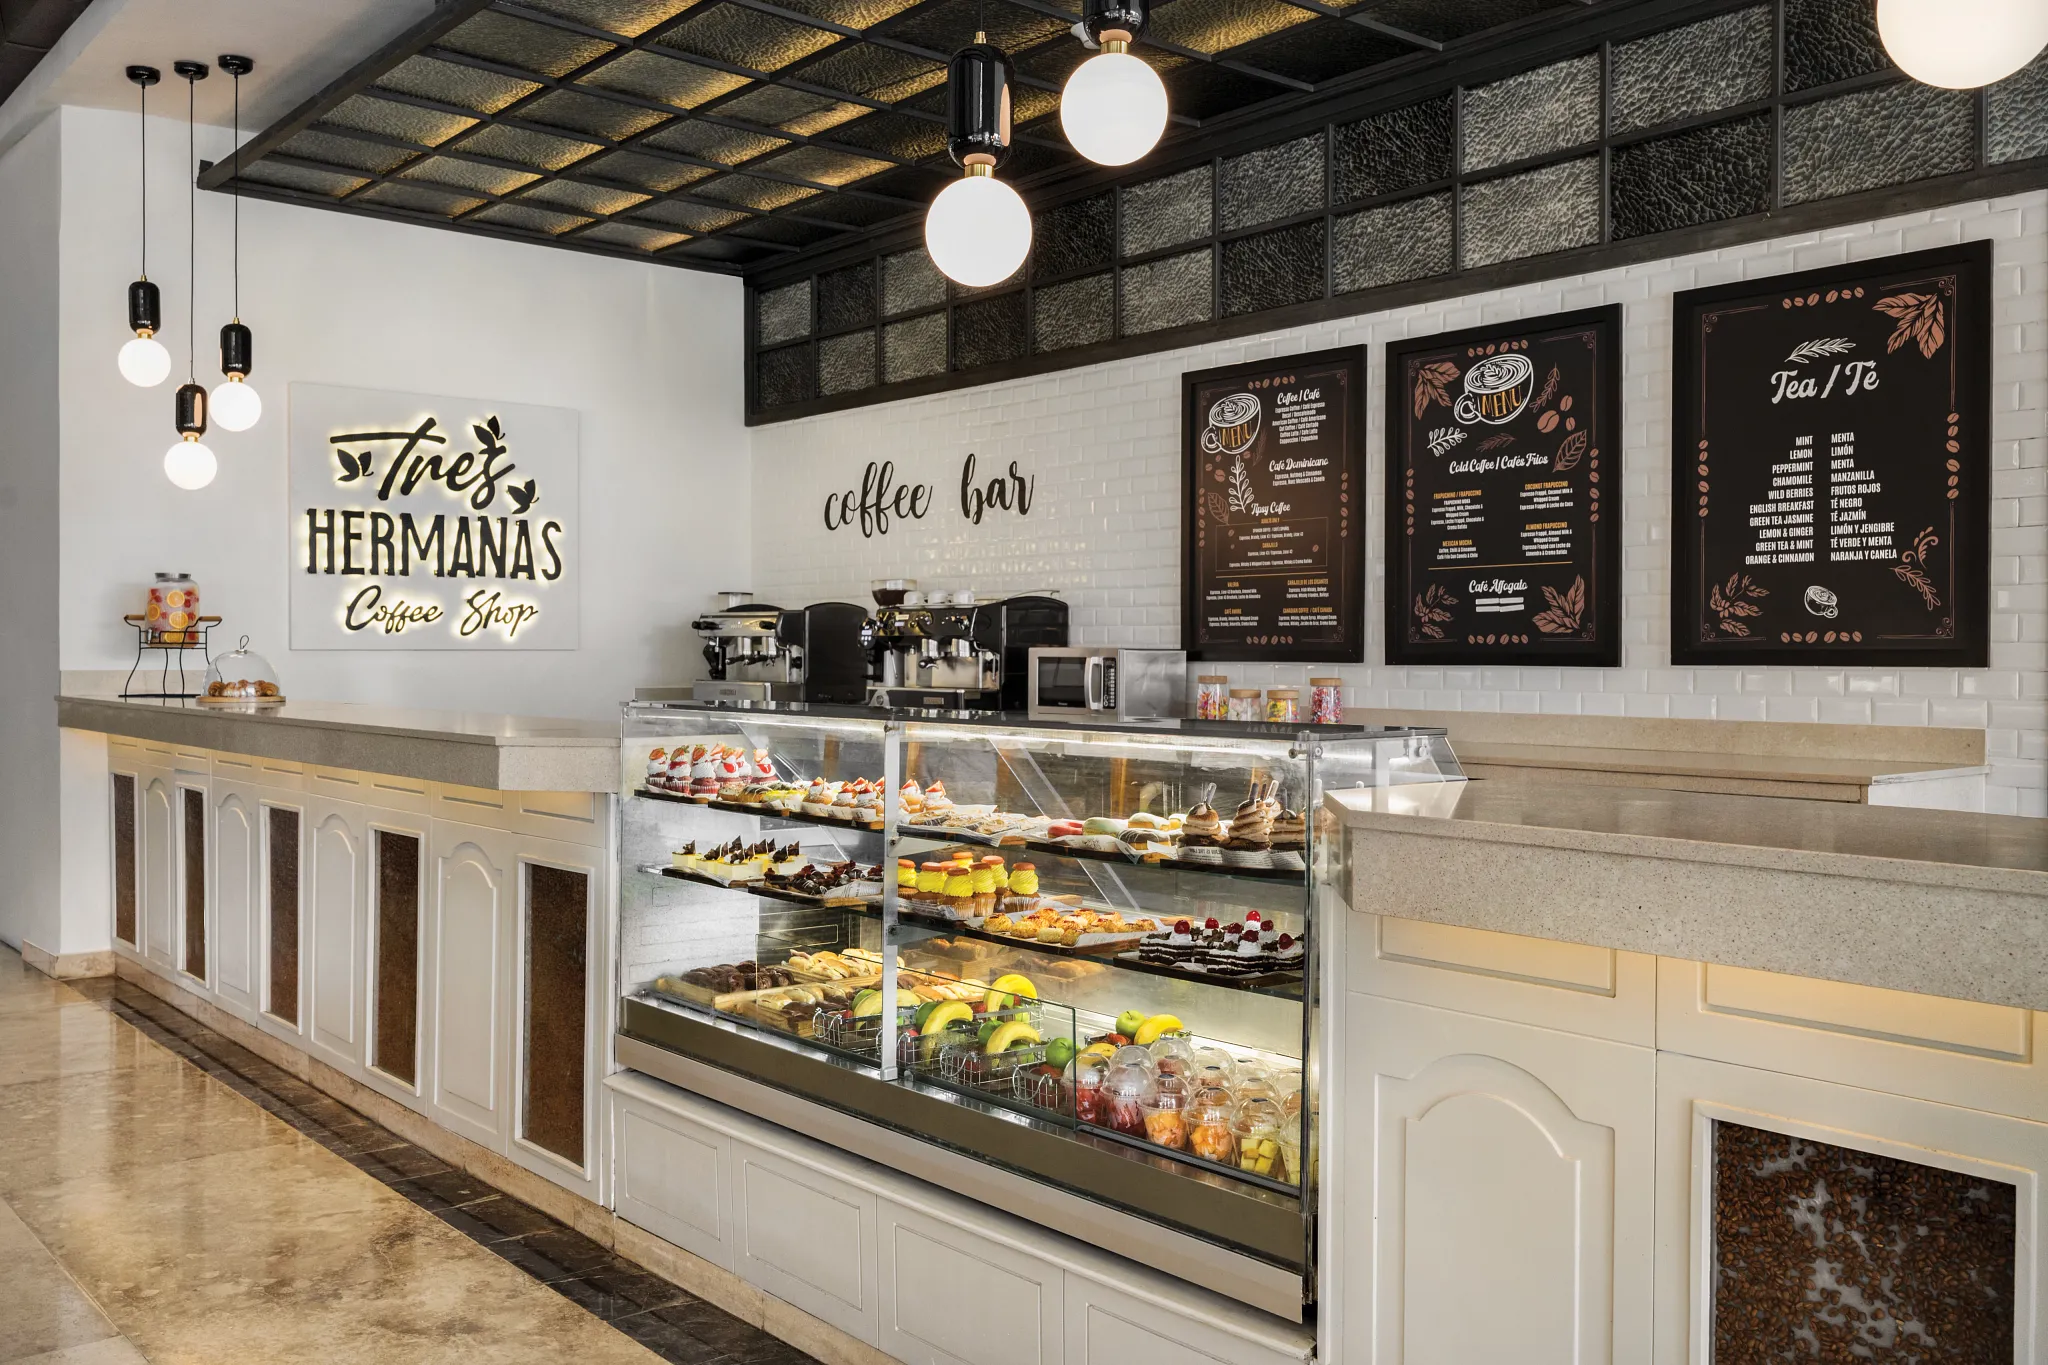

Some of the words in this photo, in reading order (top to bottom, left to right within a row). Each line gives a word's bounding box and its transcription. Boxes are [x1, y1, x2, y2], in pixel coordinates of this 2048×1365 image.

[1770, 370, 1818, 404] Tea
[1820, 364, 1841, 398] /
[1845, 360, 1879, 396] Té
[1277, 392, 1298, 406] Coffee
[1304, 388, 1320, 401] Café
[1482, 386, 1521, 417] MENU
[1796, 435, 1813, 446] MINT
[1831, 432, 1854, 443] MENTA
[1790, 448, 1812, 460] LEMON
[1831, 443, 1853, 456] LIMÓN
[330, 417, 515, 510] Tres
[1269, 460, 1285, 472] Café
[1286, 458, 1328, 470] Dominicano
[1449, 460, 1469, 474] Cold
[1469, 459, 1494, 474] Coffee
[1495, 457, 1500, 470] /
[1501, 456, 1524, 469] Cafés
[1772, 461, 1813, 474] PEPPERMINT
[1831, 458, 1854, 470] MENTA
[1773, 474, 1812, 487] CHAMOMILE
[1831, 470, 1875, 483] MANZANILLA
[824, 461, 933, 538] coffee
[961, 453, 1034, 525] bar
[1768, 490, 1784, 500] WILD
[1786, 488, 1813, 498] BERRIES
[1831, 484, 1856, 496] FRUTOS
[1858, 482, 1881, 494] ROJOS
[1251, 503, 1269, 516] Tipsy
[1270, 502, 1291, 515] Coffee
[1750, 503, 1776, 514] ENGLISH
[1778, 500, 1814, 512] BREAKFAST
[1831, 498, 1838, 509] TÉ
[1840, 498, 1862, 508] NEGRO
[1750, 516, 1770, 526] GREEN
[1771, 516, 1782, 525] TEA
[1784, 513, 1813, 524] JASMINE
[1831, 511, 1838, 522] TÉ
[1839, 509, 1866, 521] JAZMÍN
[1760, 528, 1781, 539] LEMON
[1783, 528, 1788, 537] &
[1789, 526, 1813, 537] GINGER
[1831, 523, 1852, 535] LIMÓN
[1854, 524, 1859, 534] Y
[1860, 522, 1894, 533] JENGIBRE
[307, 508, 562, 580] HERMANAS
[1756, 542, 1776, 552] GREEN
[1777, 541, 1788, 550] TEA
[1790, 541, 1795, 550] &
[1797, 540, 1813, 549] MINT
[1831, 537, 1838, 548] TÉ
[1839, 537, 1861, 548] VERDE
[1862, 537, 1867, 546] Y
[1868, 536, 1892, 546] MENTA
[1746, 554, 1771, 565] ORANGE
[1772, 554, 1777, 563] &
[1778, 552, 1814, 563] CINNAMON
[1831, 550, 1863, 561] NARANJA
[1865, 550, 1869, 560] Y
[1871, 549, 1897, 559] CANELA
[1469, 580, 1488, 594] Café
[1489, 579, 1528, 594] Affogato
[345, 585, 443, 634] Coffee
[460, 589, 538, 636] Shop
